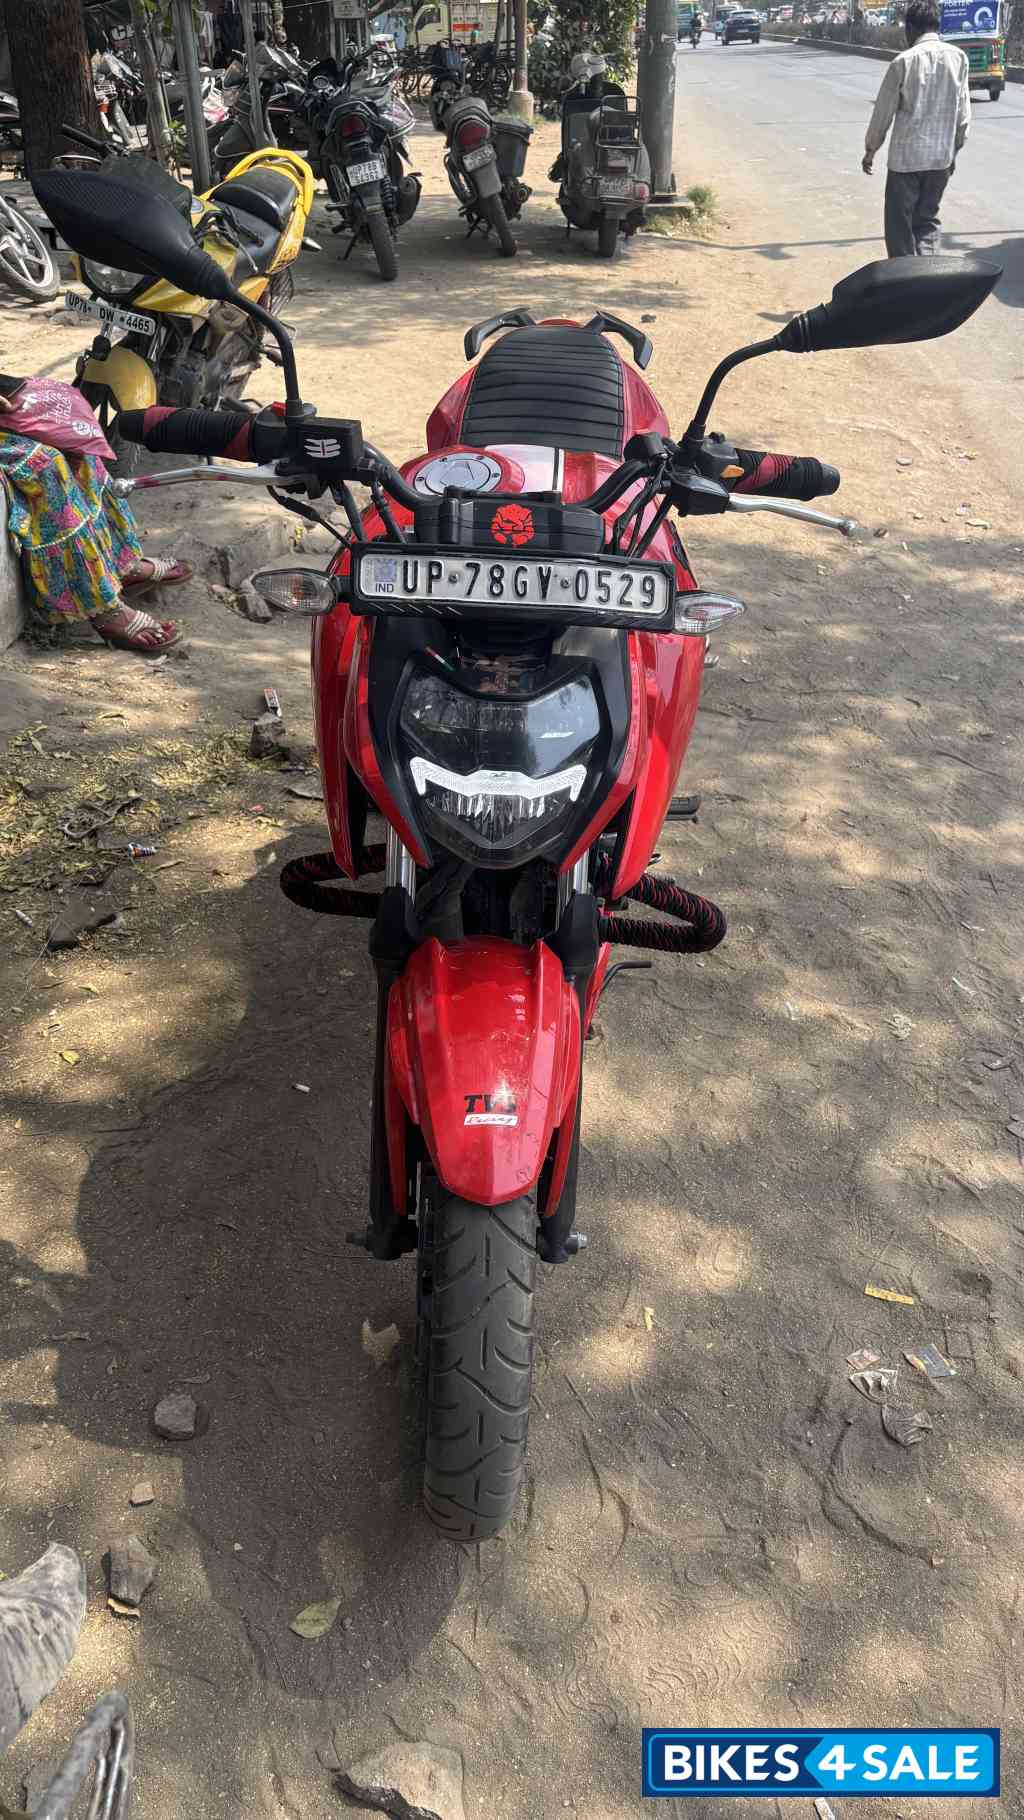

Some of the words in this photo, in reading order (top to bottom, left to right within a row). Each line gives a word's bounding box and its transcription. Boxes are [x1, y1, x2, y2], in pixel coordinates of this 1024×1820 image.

[375, 583, 394, 593] IND
[403, 559, 443, 594] UP
[575, 568, 656, 608] 0529
